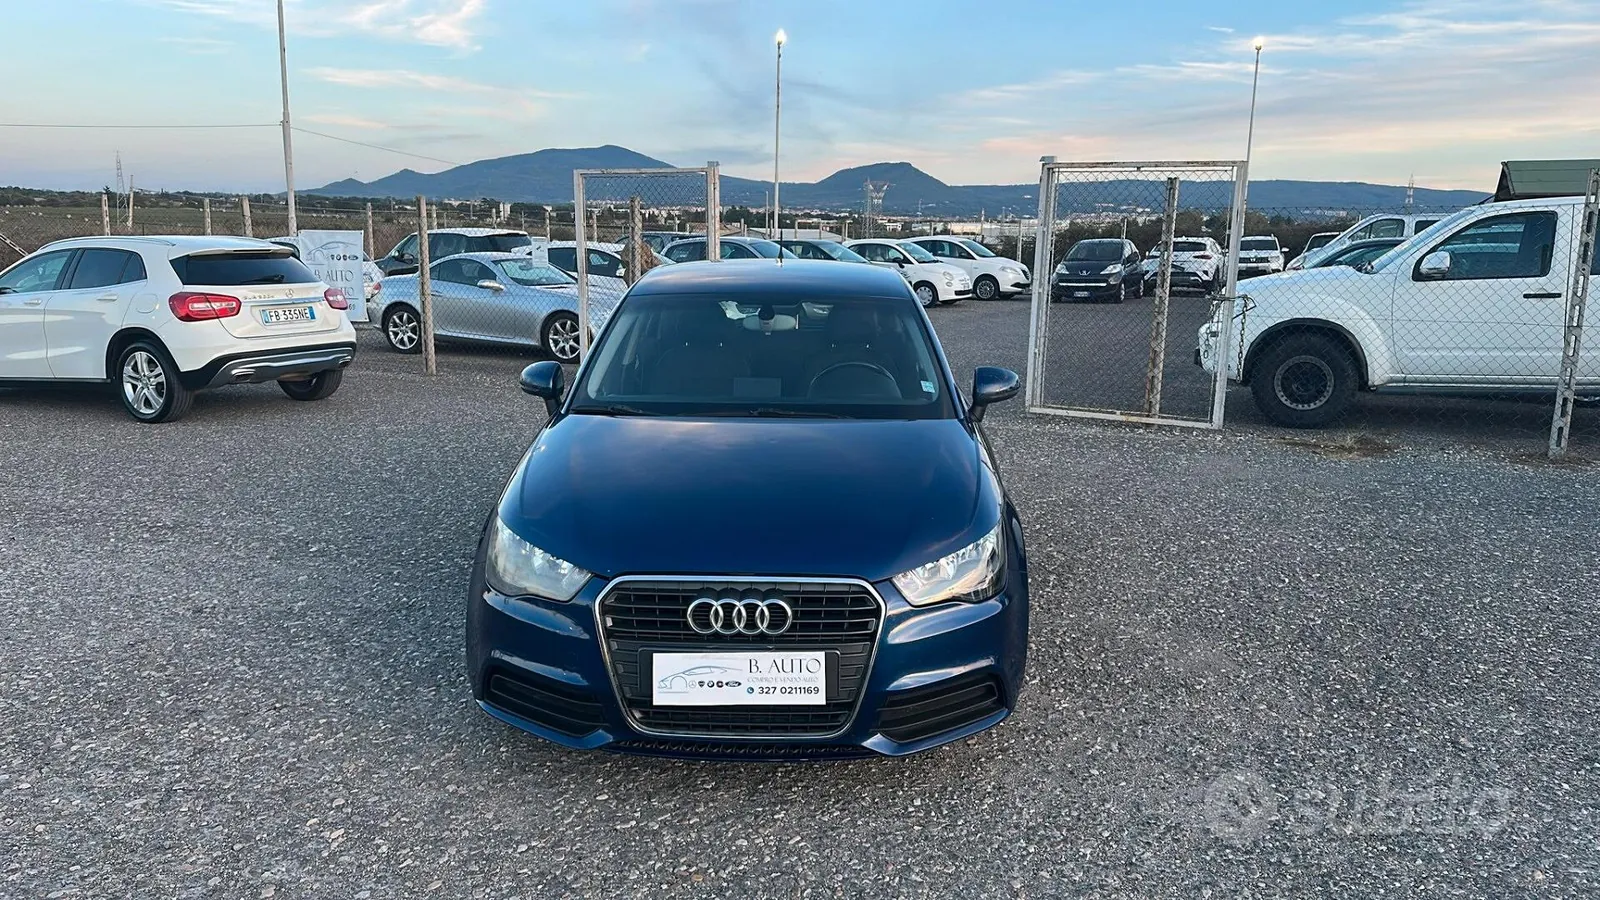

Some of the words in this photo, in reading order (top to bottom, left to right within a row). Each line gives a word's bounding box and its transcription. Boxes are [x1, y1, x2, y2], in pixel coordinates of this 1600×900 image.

[325, 269, 354, 282] AUTO
[749, 658, 762, 674] B.
[768, 658, 821, 674] AUTO
[758, 686, 777, 695] 327
[780, 686, 820, 695] 0211169
